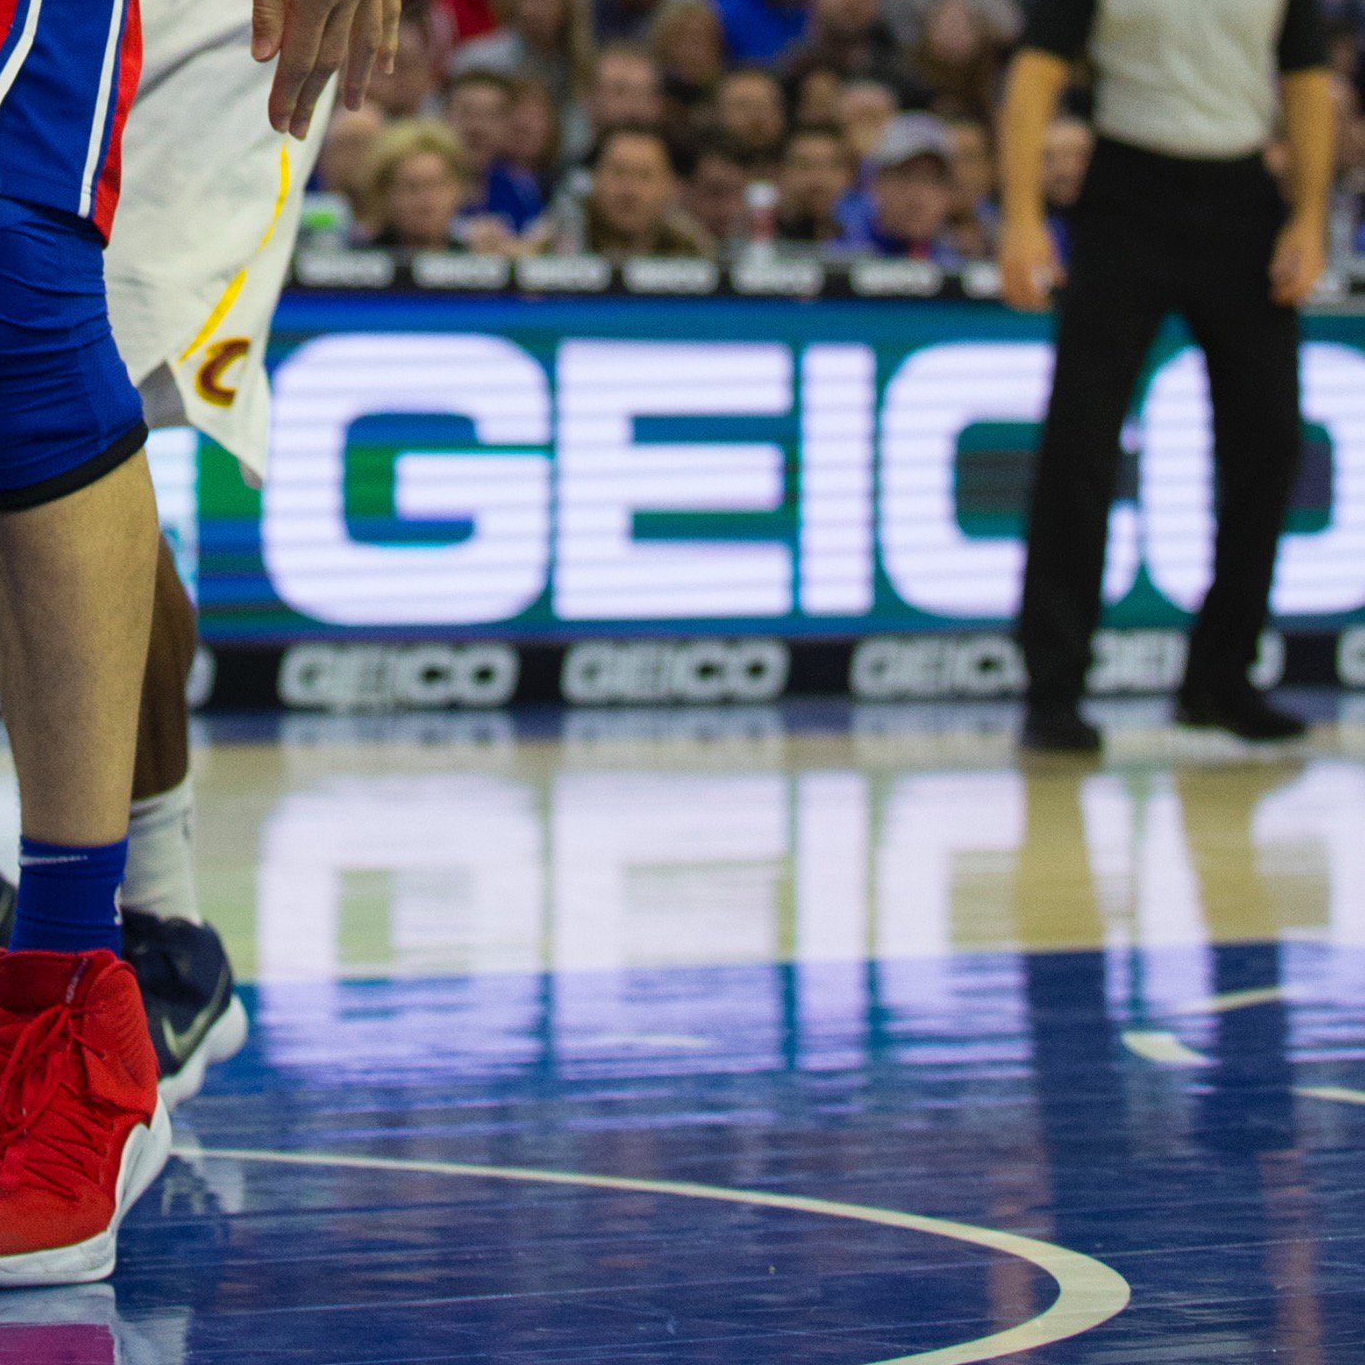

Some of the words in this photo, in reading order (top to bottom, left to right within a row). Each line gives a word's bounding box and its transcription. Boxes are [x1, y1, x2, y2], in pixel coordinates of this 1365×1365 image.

[265, 332, 1365, 627] GEICO
[279, 642, 521, 710] GEICO
[561, 639, 791, 709] GEICO
[850, 632, 1030, 699] GEIC
